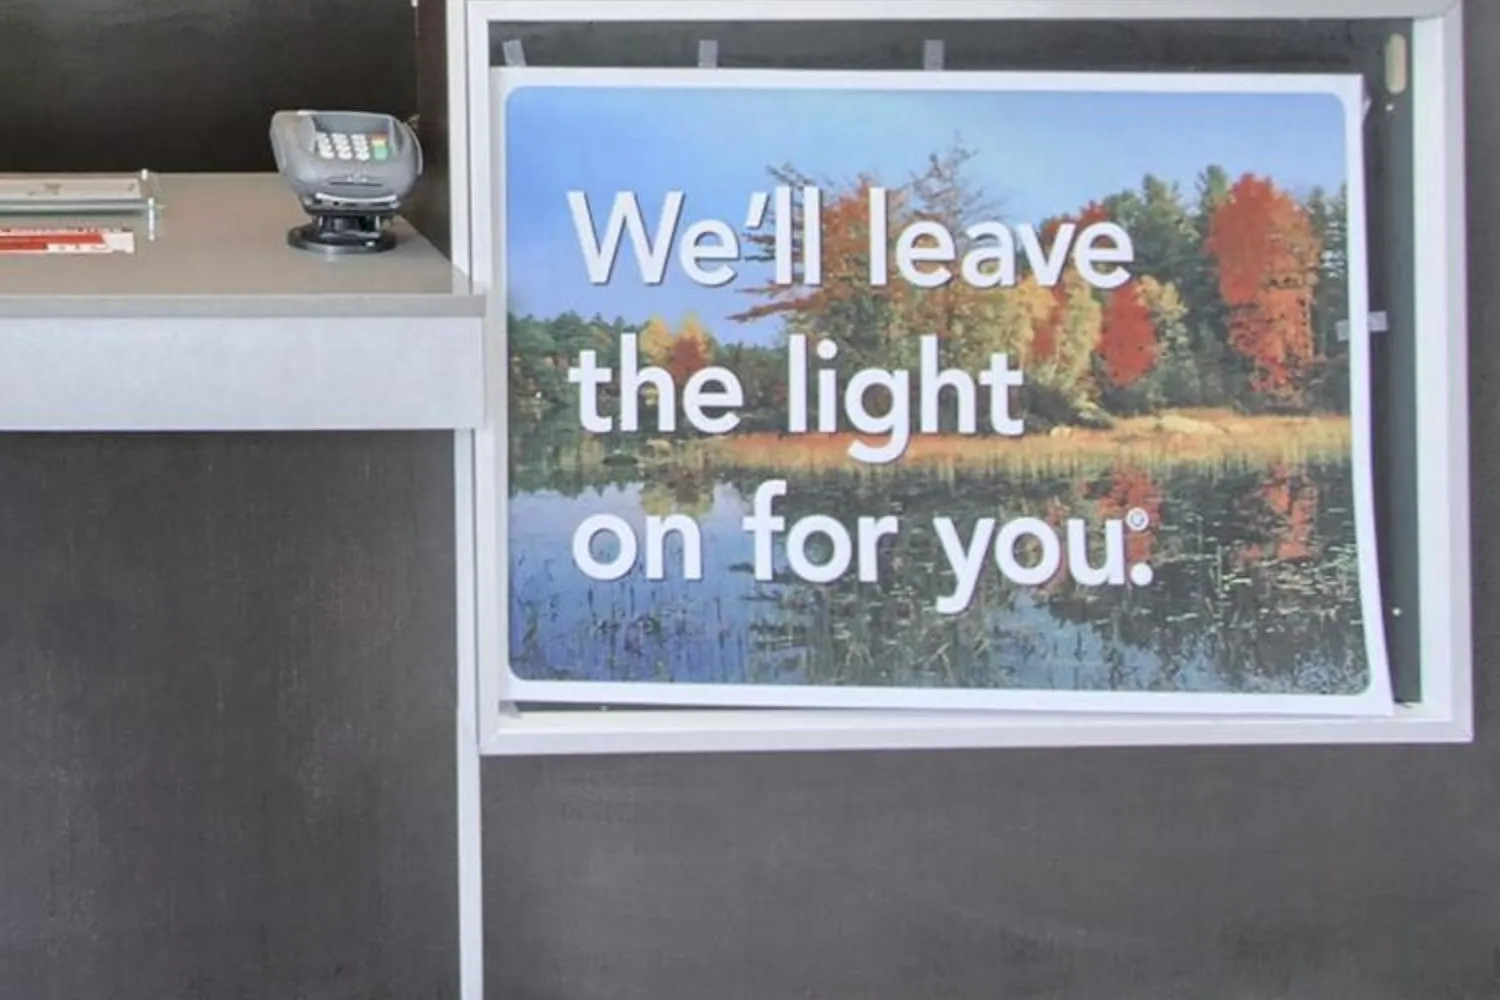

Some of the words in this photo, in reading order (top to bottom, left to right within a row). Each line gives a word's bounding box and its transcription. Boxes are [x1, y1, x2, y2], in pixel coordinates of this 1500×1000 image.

[567, 187, 823, 287] We'll
[869, 187, 1136, 288] leave
[568, 333, 744, 434] the
[789, 333, 1025, 464] light
[573, 512, 702, 584] on
[743, 479, 899, 586] for
